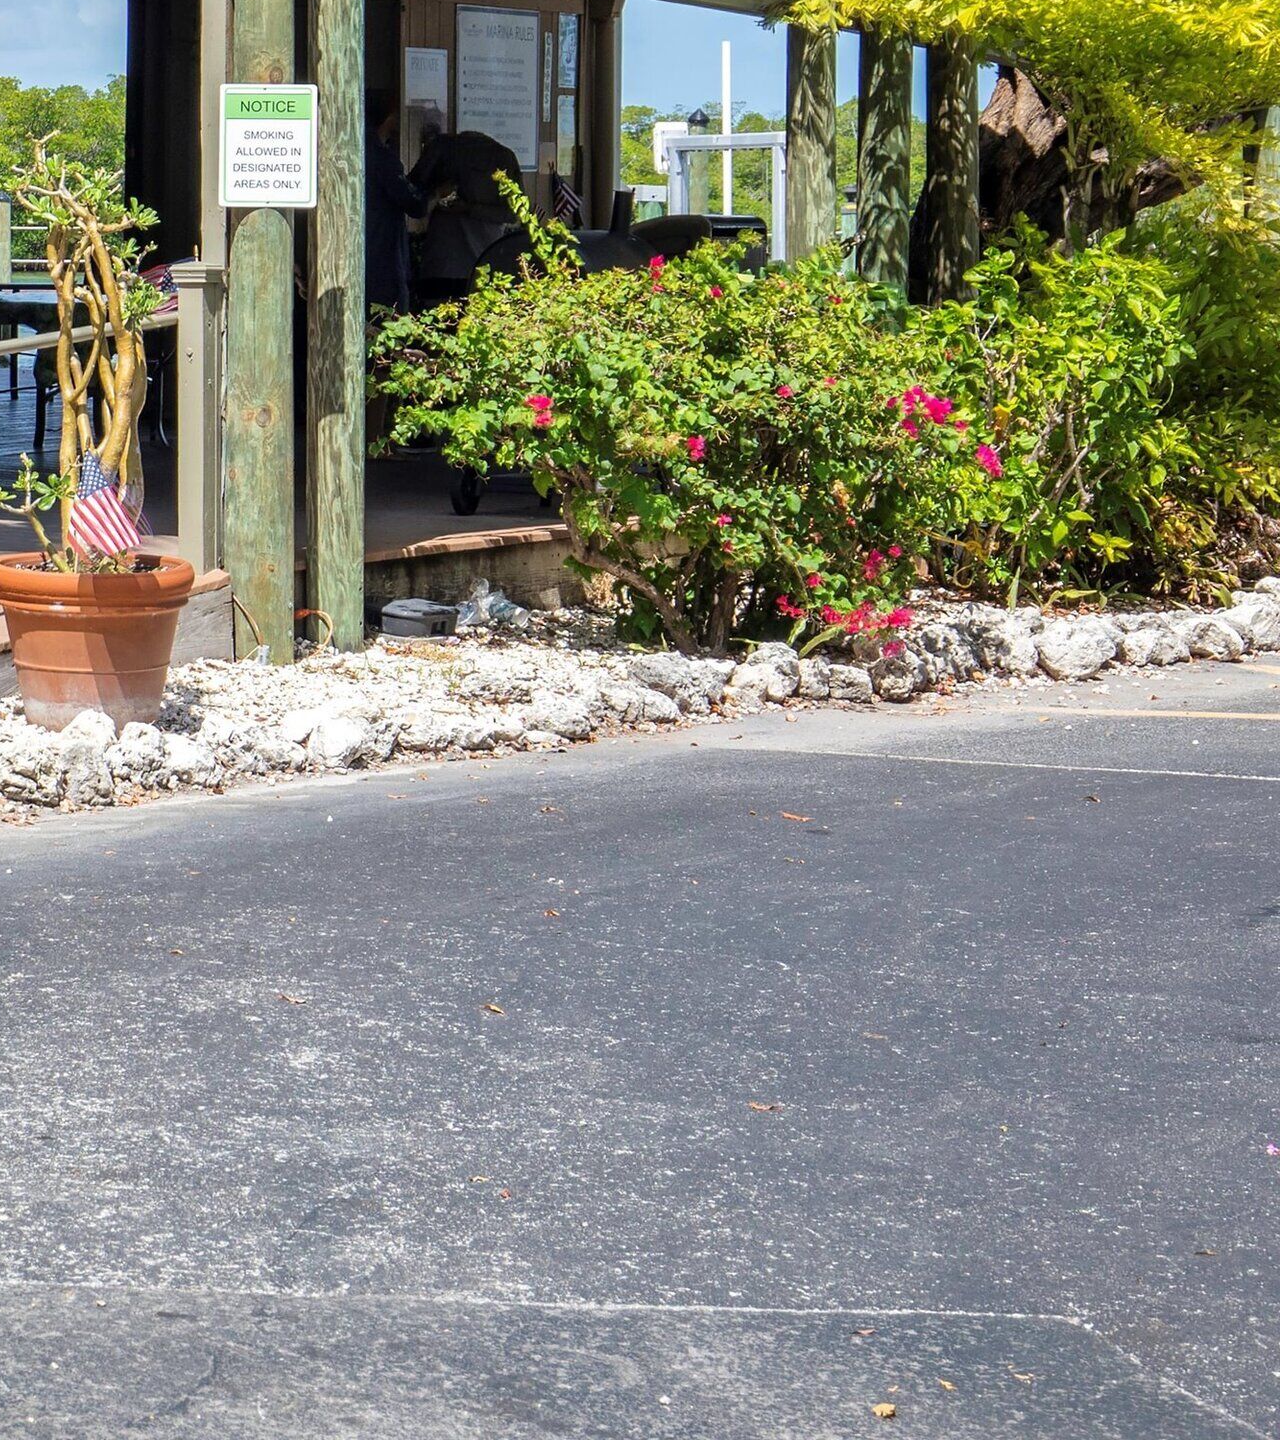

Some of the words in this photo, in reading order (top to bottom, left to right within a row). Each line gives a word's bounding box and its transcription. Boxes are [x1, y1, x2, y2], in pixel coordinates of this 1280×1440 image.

[240, 100, 297, 113] NOTICE
[243, 130, 294, 140] SMOKING
[235, 146, 288, 156] ALLOWED
[291, 147, 302, 156] IN
[233, 163, 302, 173] DESIGNATED
[233, 179, 270, 189] AREAS
[272, 179, 302, 189] ONLY
